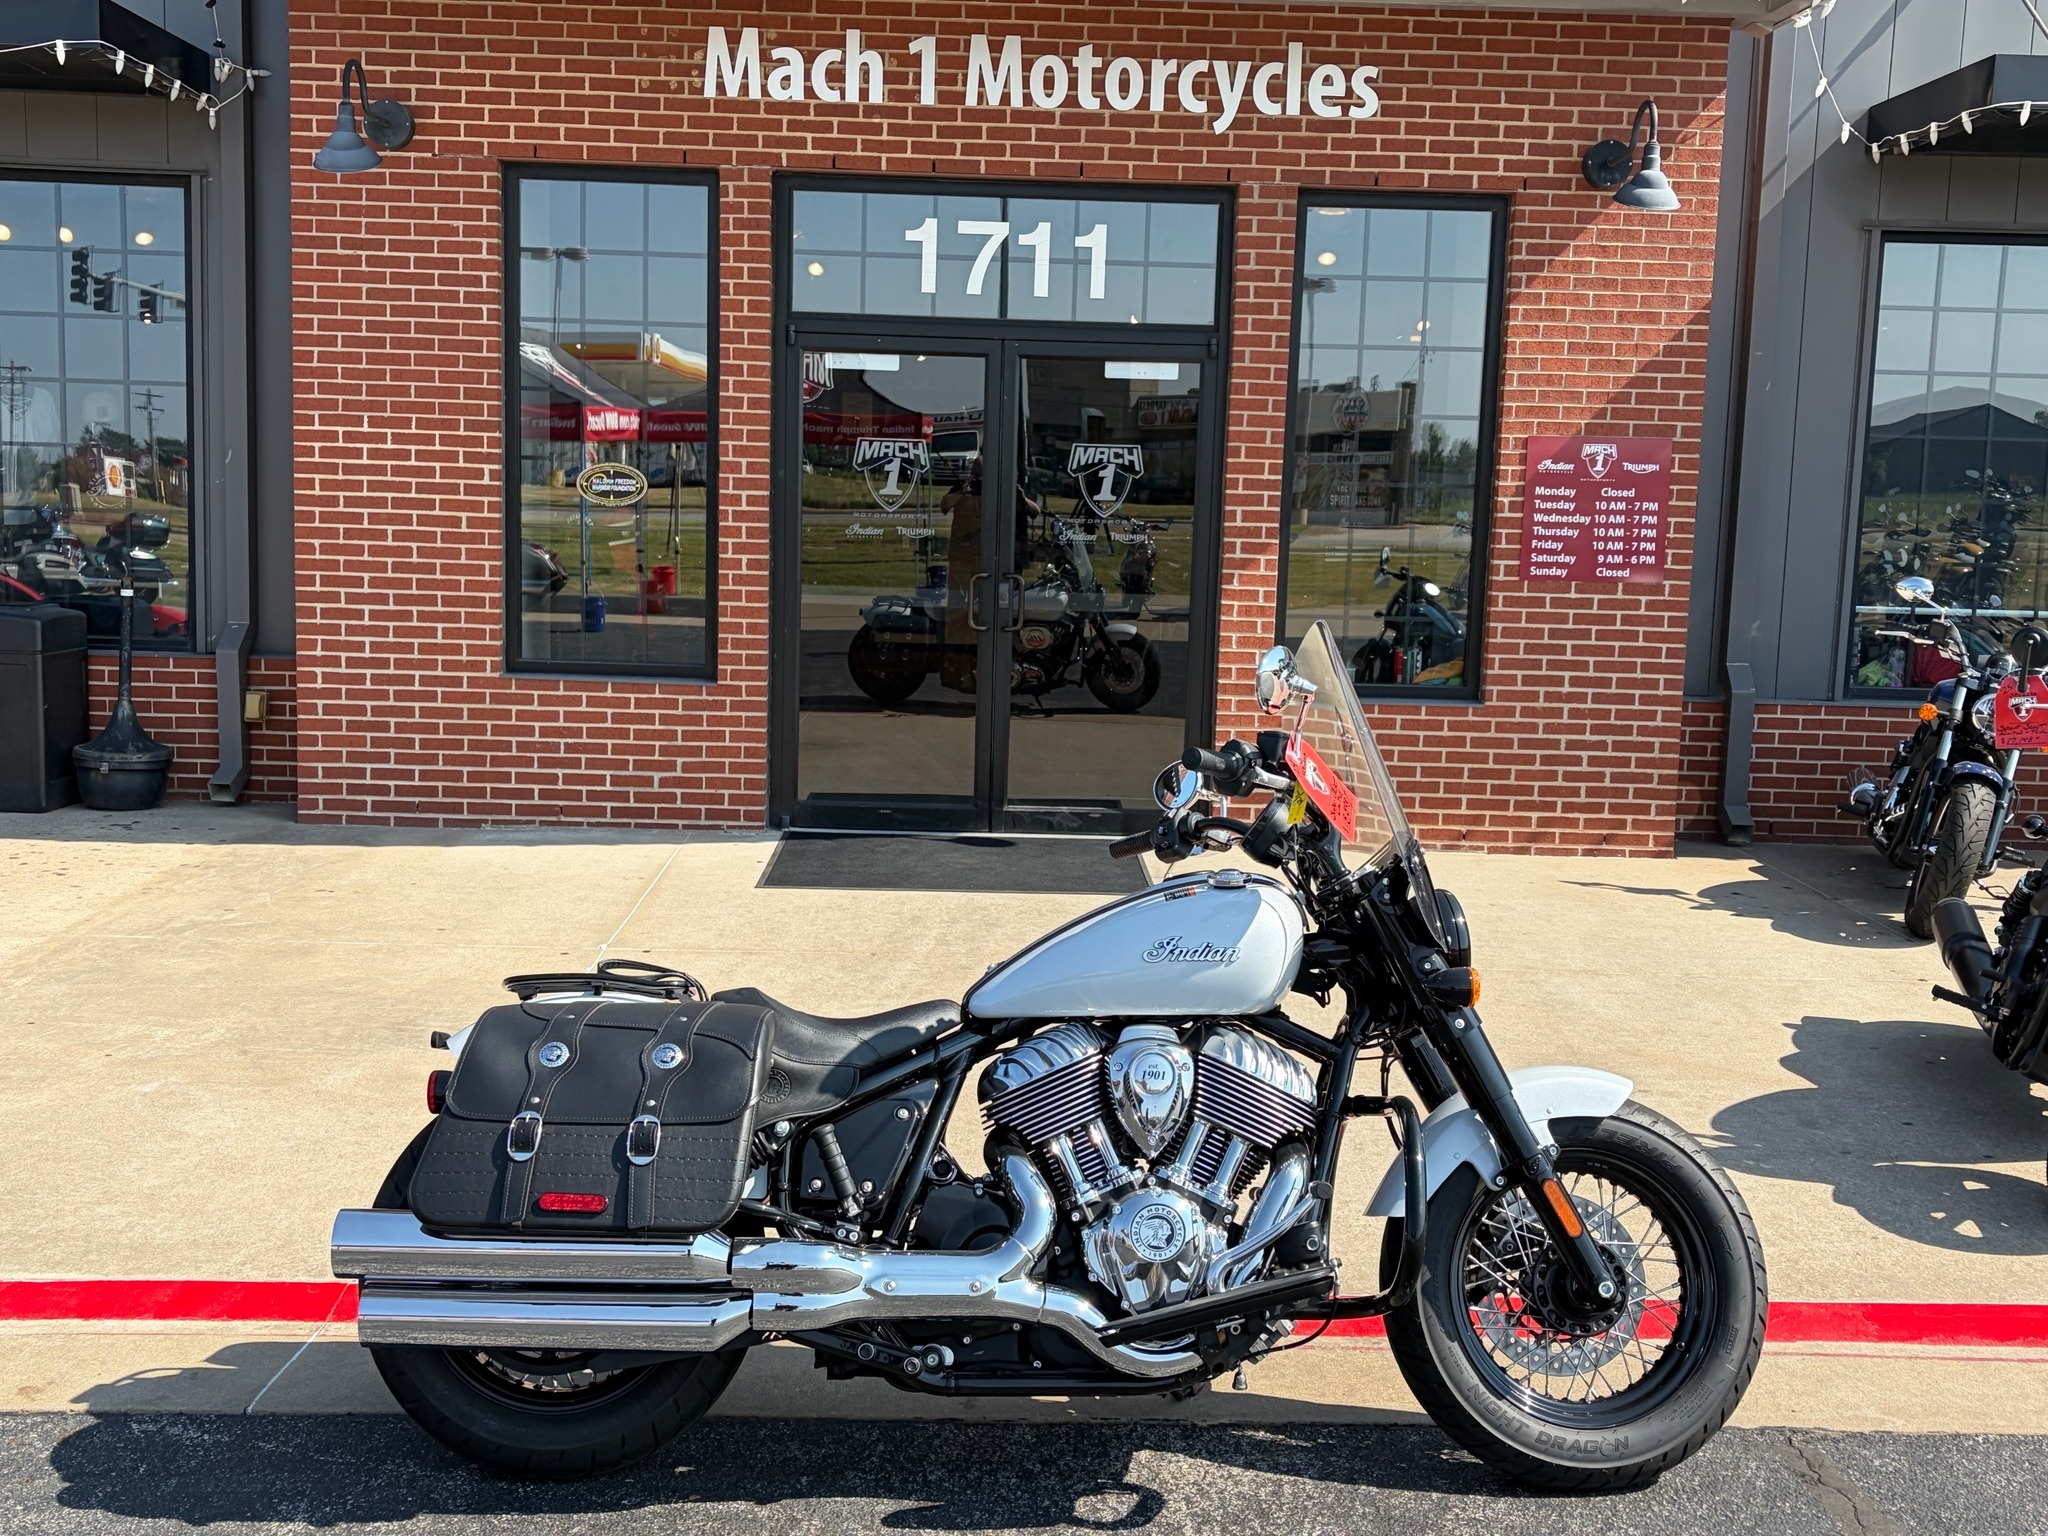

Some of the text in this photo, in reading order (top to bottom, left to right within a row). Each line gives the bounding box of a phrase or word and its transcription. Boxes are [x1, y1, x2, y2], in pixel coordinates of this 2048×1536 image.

[703, 25, 1379, 136] Mach 1 Motorcycles
[905, 217, 1108, 299] 1711
[857, 441, 927, 466] MACH
[1583, 446, 1615, 456] MACH
[1072, 447, 1140, 471] MACH
[1537, 459, 1575, 470] Indian
[1593, 453, 1605, 470] 1
[879, 457, 902, 495] 1
[1093, 464, 1117, 501] 1
[1535, 486, 1635, 498] Monday Closed
[1534, 500, 1576, 511] Tuesday
[1595, 502, 1607, 510] 10
[1609, 502, 1626, 510] AM
[1634, 502, 1640, 511] 7
[1643, 502, 1658, 511] PM
[1533, 513, 1591, 525] Wednesday
[1594, 515, 1607, 523] 10
[1608, 515, 1625, 524] AM
[1633, 516, 1640, 524] 7
[1642, 516, 1657, 524] PM
[845, 523, 935, 537] Indian TRIUMPH
[1059, 530, 1148, 542] Indian TRIUMPH
[1533, 526, 1579, 538] Thursday
[1593, 528, 1605, 536] 10
[1607, 528, 1624, 537] AM
[1632, 529, 1639, 537] 7
[1641, 529, 1656, 538] PM
[1532, 540, 1563, 551] Friday
[1592, 541, 1605, 550] 10
[1606, 542, 1623, 550] AM
[1631, 542, 1638, 551] 7
[1640, 542, 1655, 551] PM
[1531, 553, 1576, 565] Saturday
[1597, 554, 1604, 563] 9
[1606, 555, 1623, 563] AM
[1631, 555, 1637, 564] 6
[1639, 556, 1655, 564] PM
[1530, 566, 1630, 577] Sunday Closed
[1142, 936, 1241, 965] Indian
[1142, 1070, 1165, 1080] 1901
[1133, 1207, 1182, 1249] INDIAN MOTORCYCLE
[1467, 1383, 1629, 1457] NIGHT DRAGON
